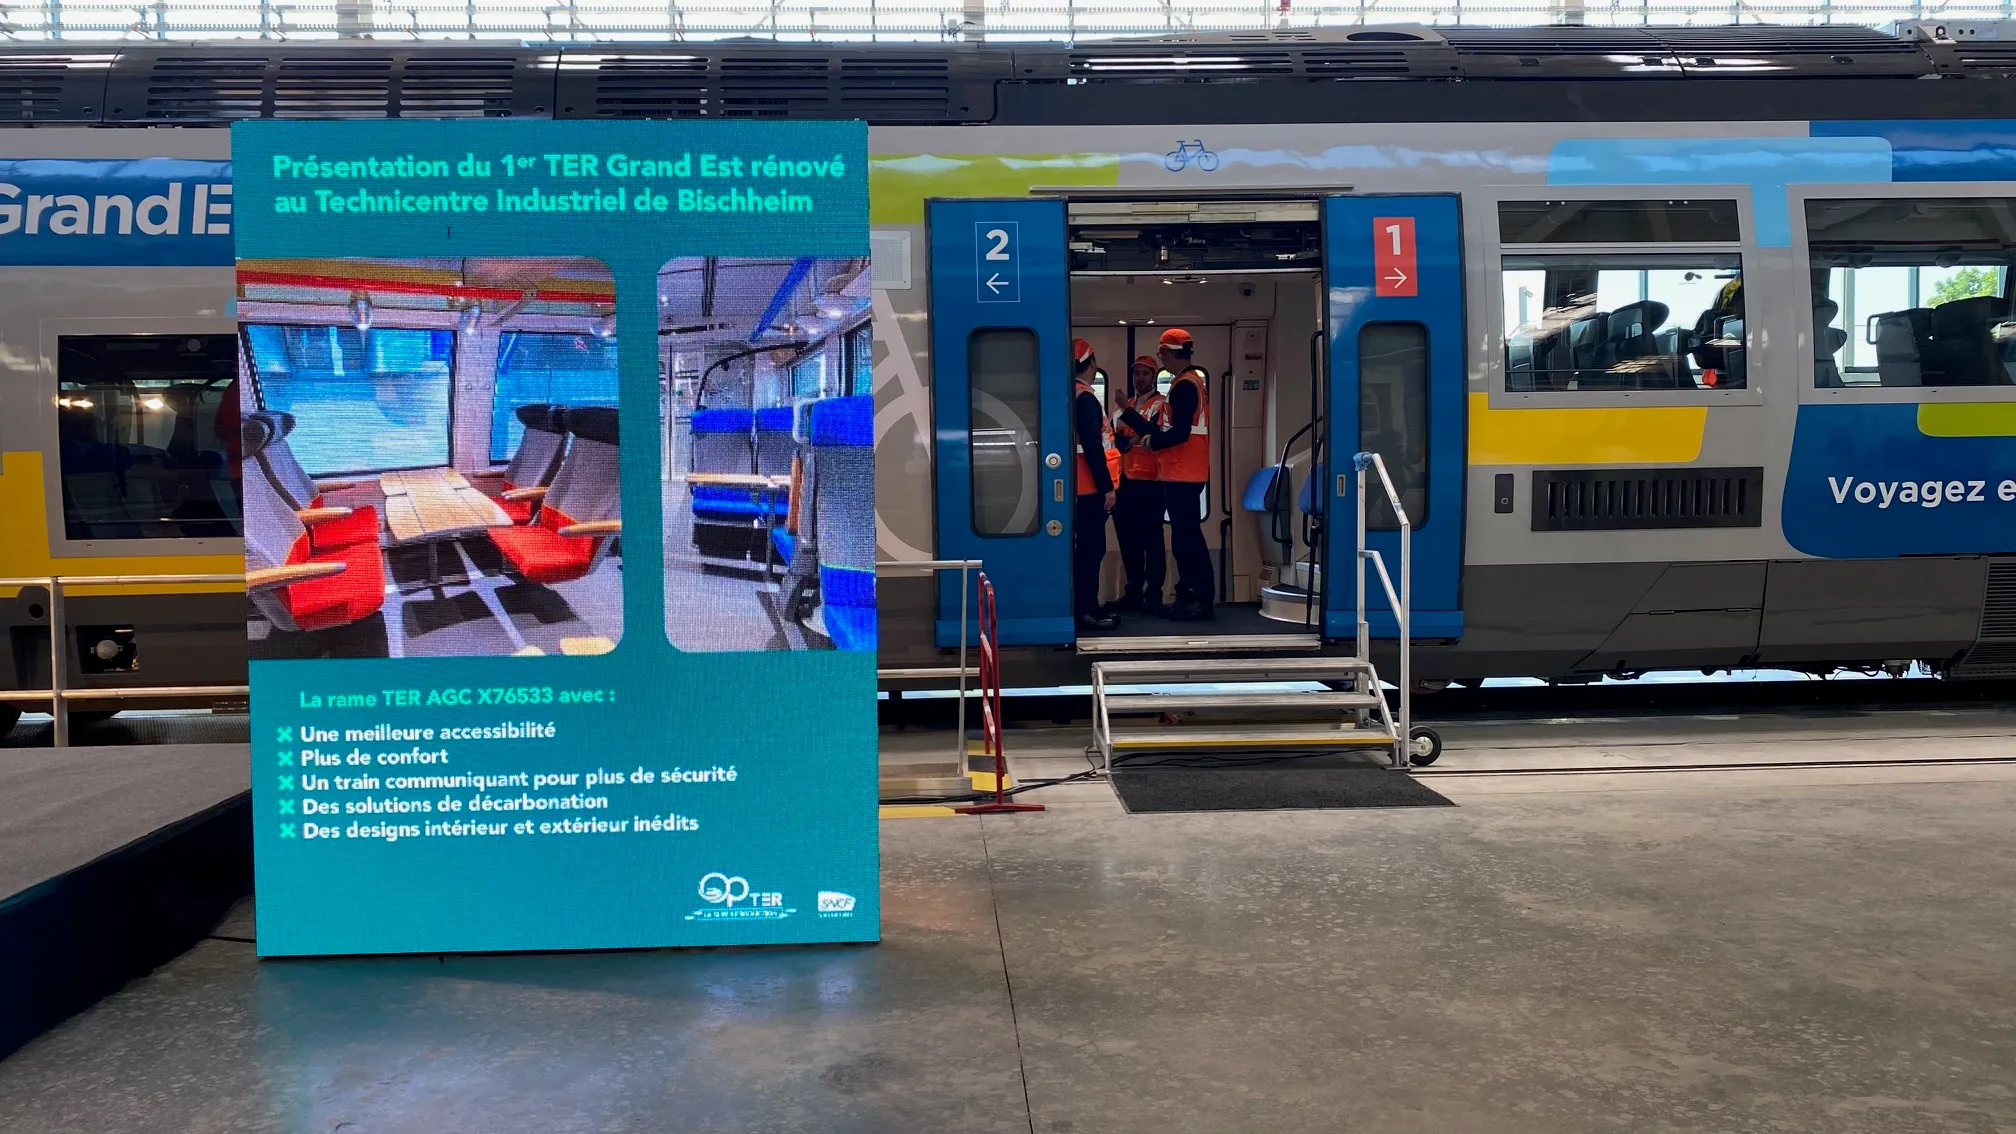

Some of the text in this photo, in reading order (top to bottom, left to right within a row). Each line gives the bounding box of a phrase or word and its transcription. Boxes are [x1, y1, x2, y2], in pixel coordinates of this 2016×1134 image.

[273, 155, 449, 178] Présentation
[457, 153, 491, 177] du
[544, 154, 599, 177] TER
[606, 153, 691, 177] Grand
[700, 154, 744, 177] Est
[751, 154, 845, 178] rénové
[274, 187, 813, 212] au Technicentre Industriel de Bischheim
[985, 229, 1010, 260] 2
[1386, 224, 1401, 255] 1
[1828, 476, 1986, 509] Voyagez
[300, 691, 322, 708] La
[328, 692, 377, 707] rame
[382, 689, 421, 706] TER
[426, 688, 473, 705] AGC
[477, 687, 553, 705] X76533
[558, 689, 604, 703] avec
[300, 721, 556, 743] Une meilleure accessibilité
[301, 746, 449, 767] Plus de confort
[302, 765, 738, 792] Un train communiquant pour plus de sécurité
[302, 793, 608, 815] Des solutions de décarbonation
[303, 813, 700, 842] Des designs intérieur et extérieur inédits
[821, 897, 853, 910] SNCF
